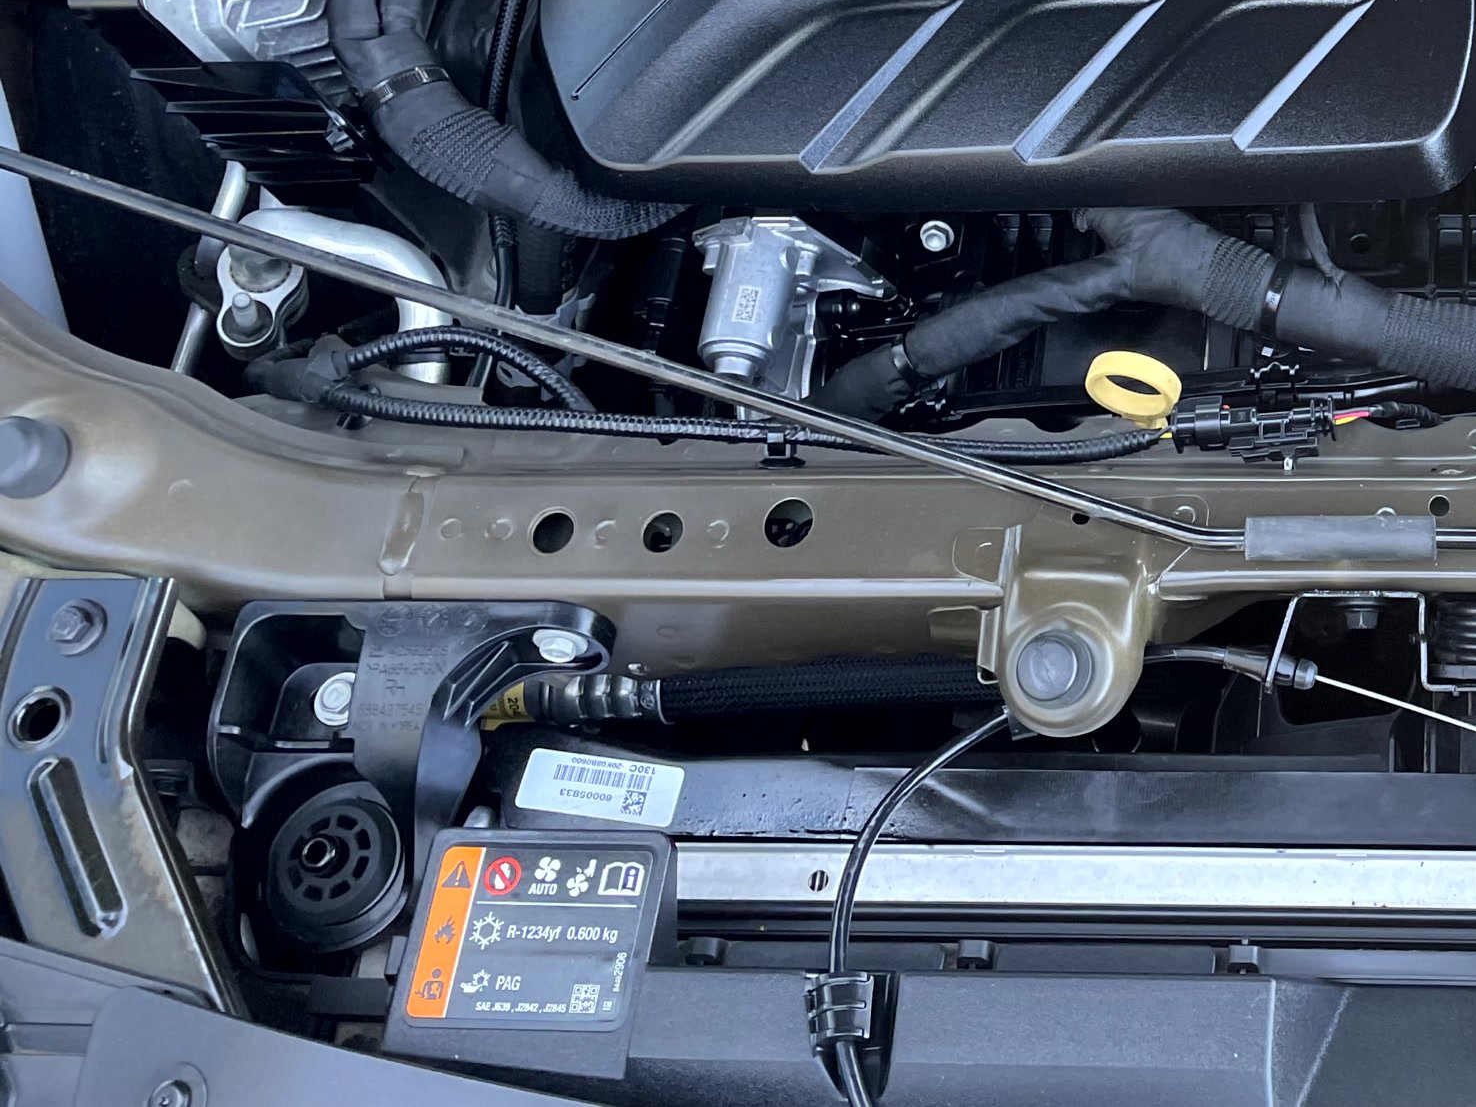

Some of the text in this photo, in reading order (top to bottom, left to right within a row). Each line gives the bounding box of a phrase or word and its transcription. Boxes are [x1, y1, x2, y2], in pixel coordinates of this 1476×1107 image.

[628, 765, 656, 775] 130C
[528, 883, 558, 895] AUTO
[506, 925, 619, 943] R-1234yf 0.600 kg
[495, 975, 521, 991] PAG
[475, 1001, 491, 1011] SAE
